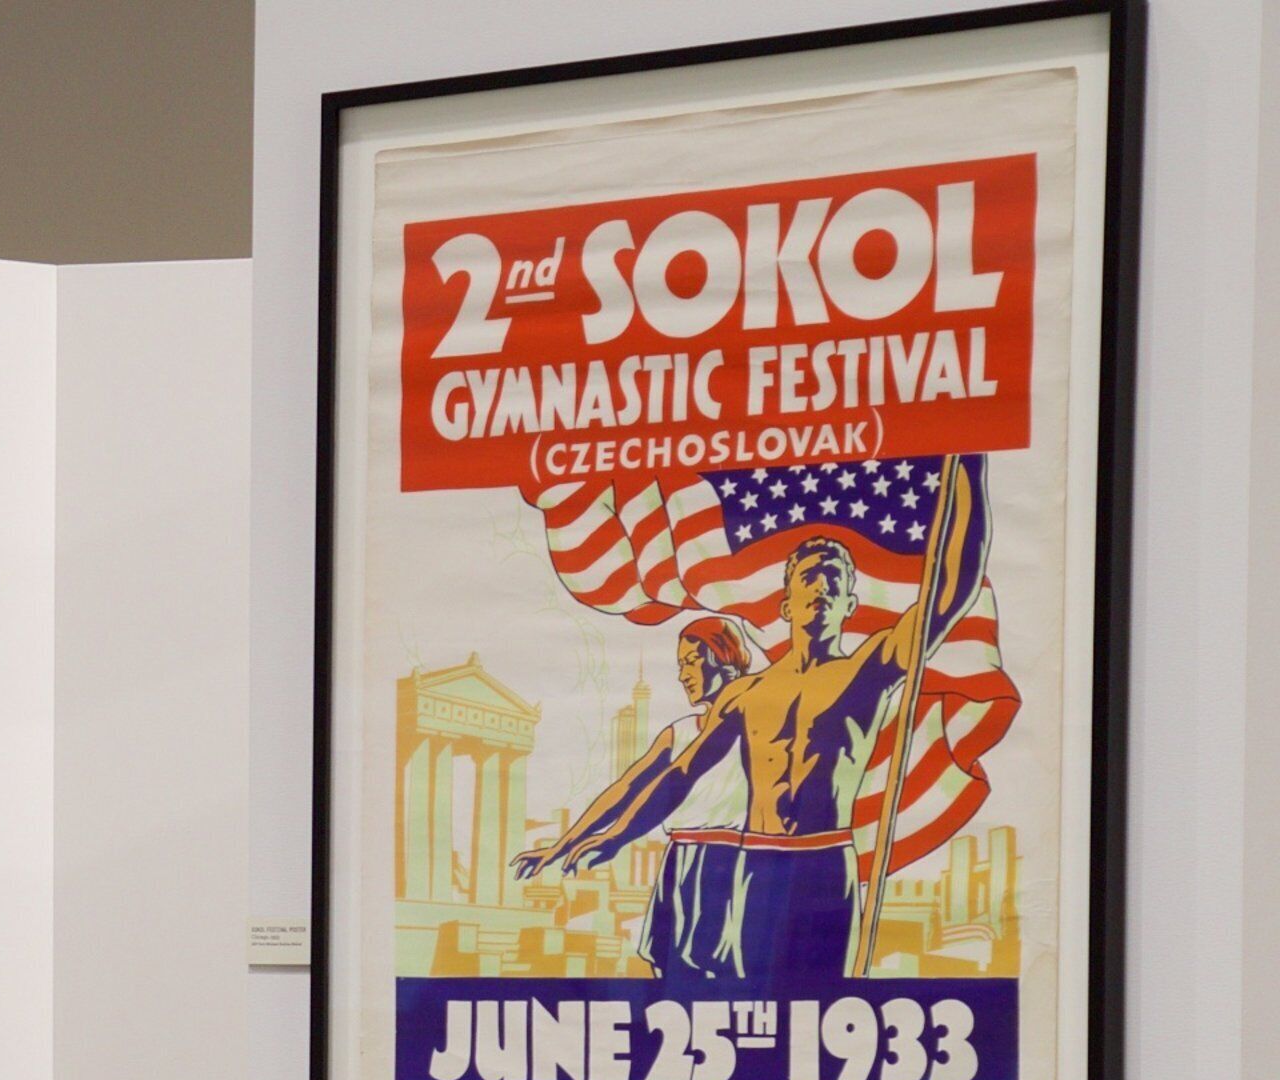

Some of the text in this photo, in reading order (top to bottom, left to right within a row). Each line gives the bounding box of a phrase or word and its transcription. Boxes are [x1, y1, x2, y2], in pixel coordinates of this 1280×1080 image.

[430, 180, 1004, 359] 2nd SOKOL
[430, 326, 998, 441] GYMNASTIC FESTIVAL
[530, 409, 884, 481] (CZECHOSLOVAK)
